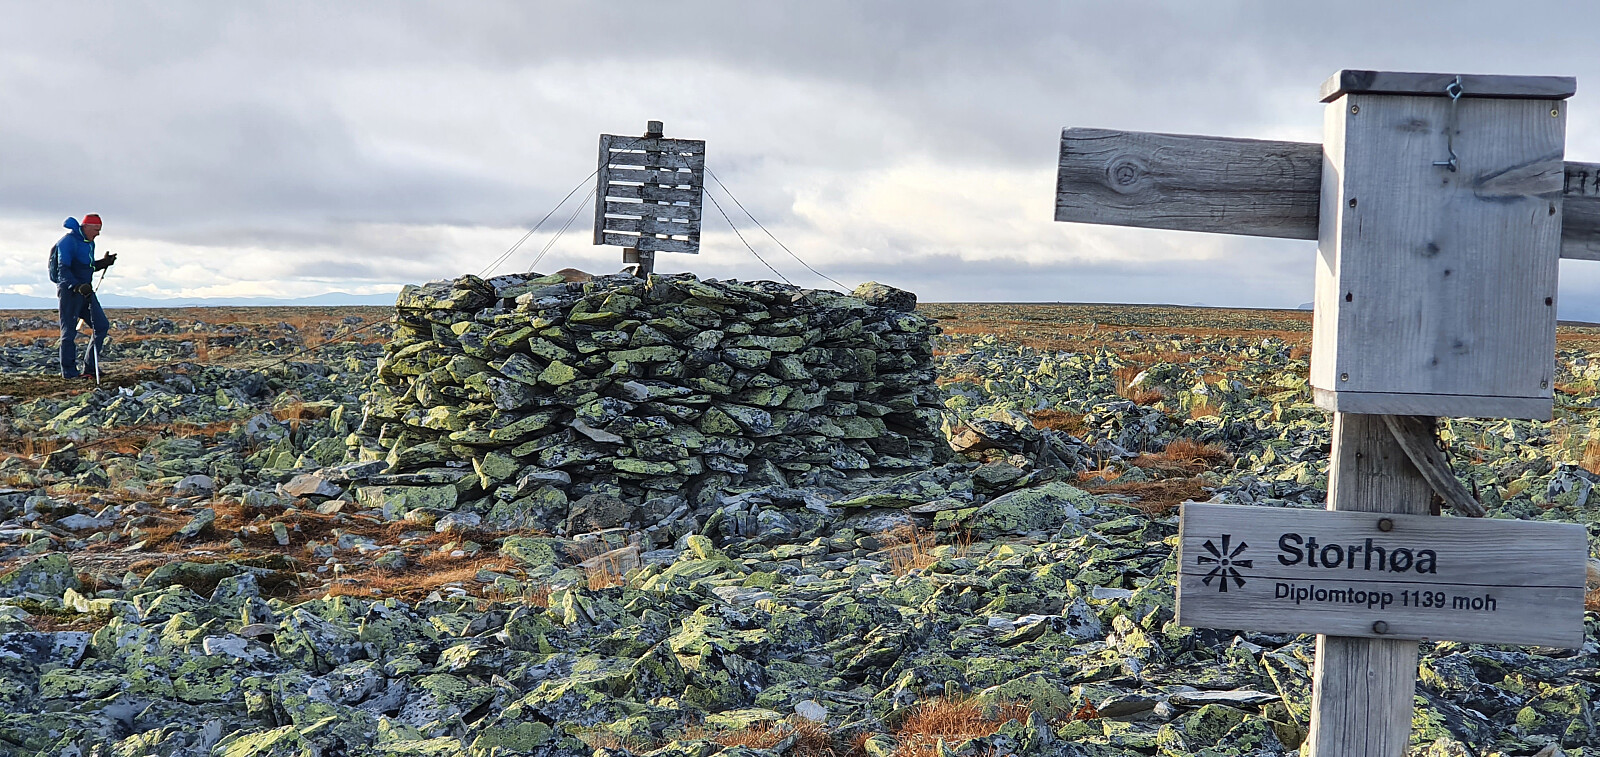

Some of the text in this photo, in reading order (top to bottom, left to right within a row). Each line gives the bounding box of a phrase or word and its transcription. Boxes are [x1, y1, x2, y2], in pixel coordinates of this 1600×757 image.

[1277, 533, 1437, 574] Storhøa
[1275, 583, 1497, 612] Diplomtopp 1139 moh
